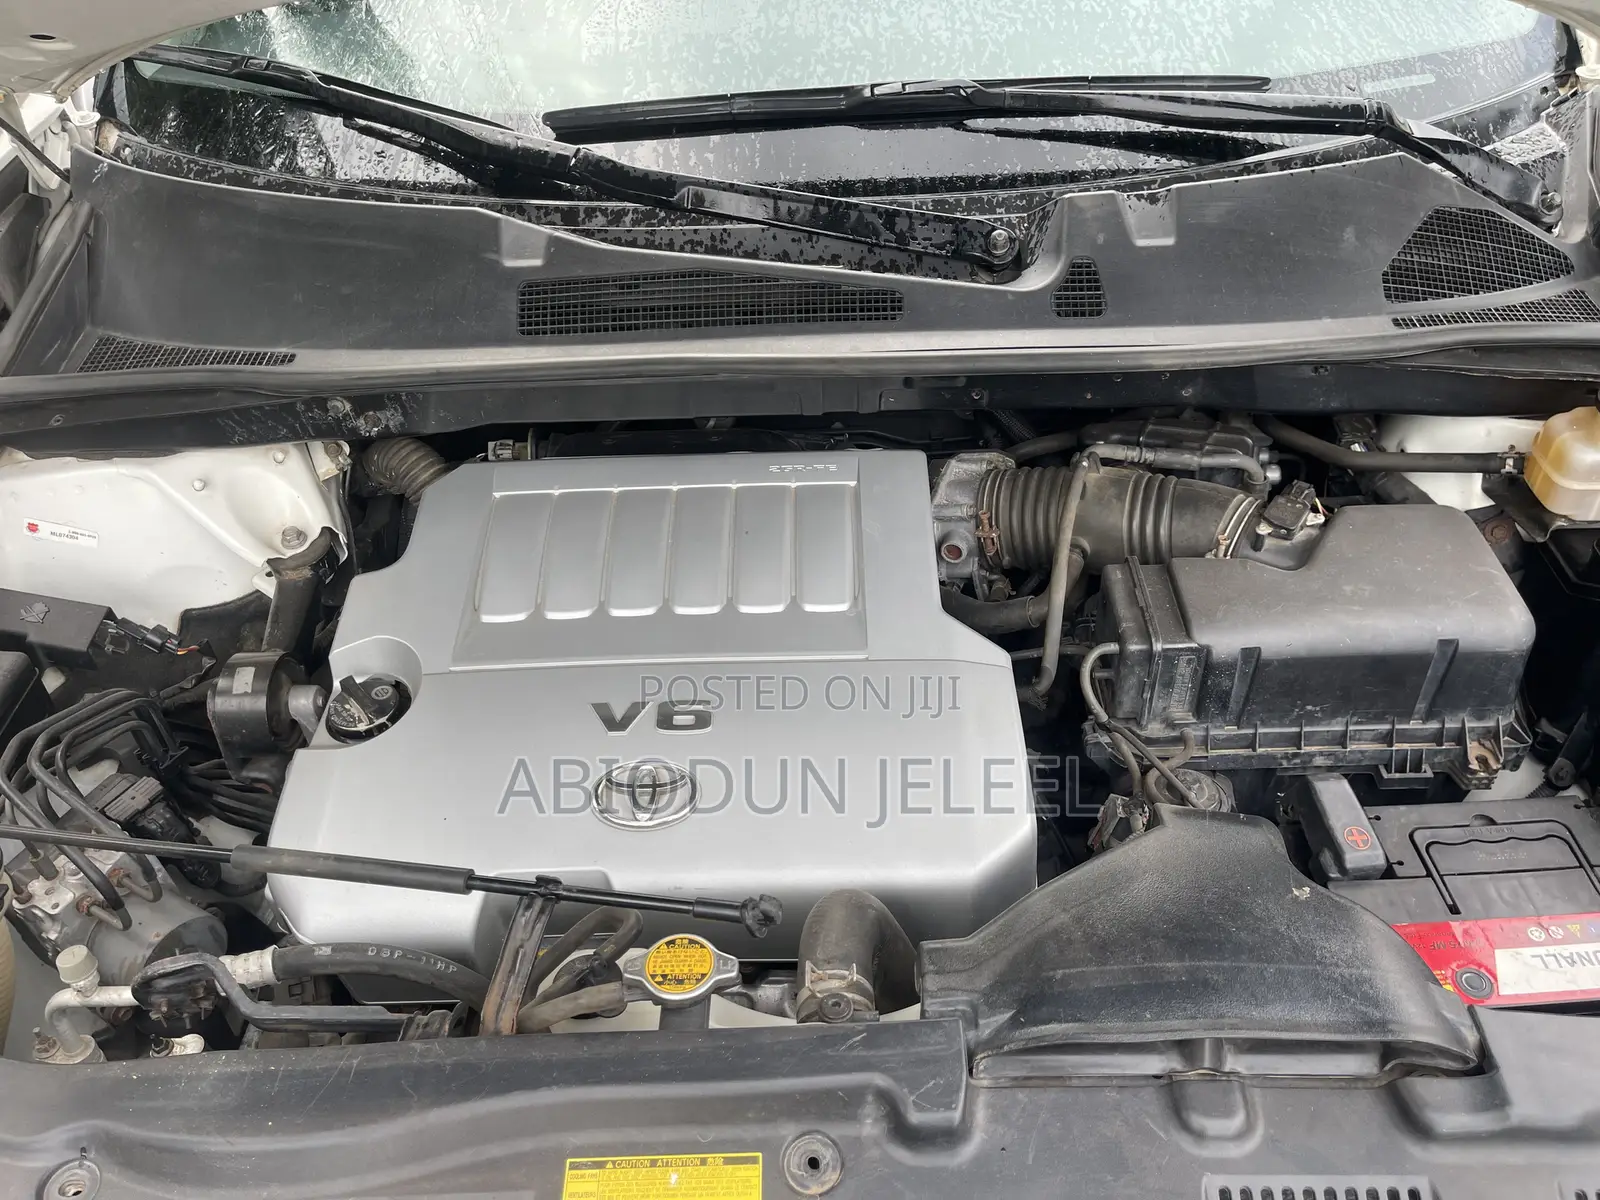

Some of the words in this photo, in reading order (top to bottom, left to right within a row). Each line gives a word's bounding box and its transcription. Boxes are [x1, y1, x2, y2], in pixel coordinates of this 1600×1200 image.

[589, 699, 715, 736] V6
[615, 1159, 651, 1168] CAUTION
[656, 1157, 701, 1167] ATTENTION
